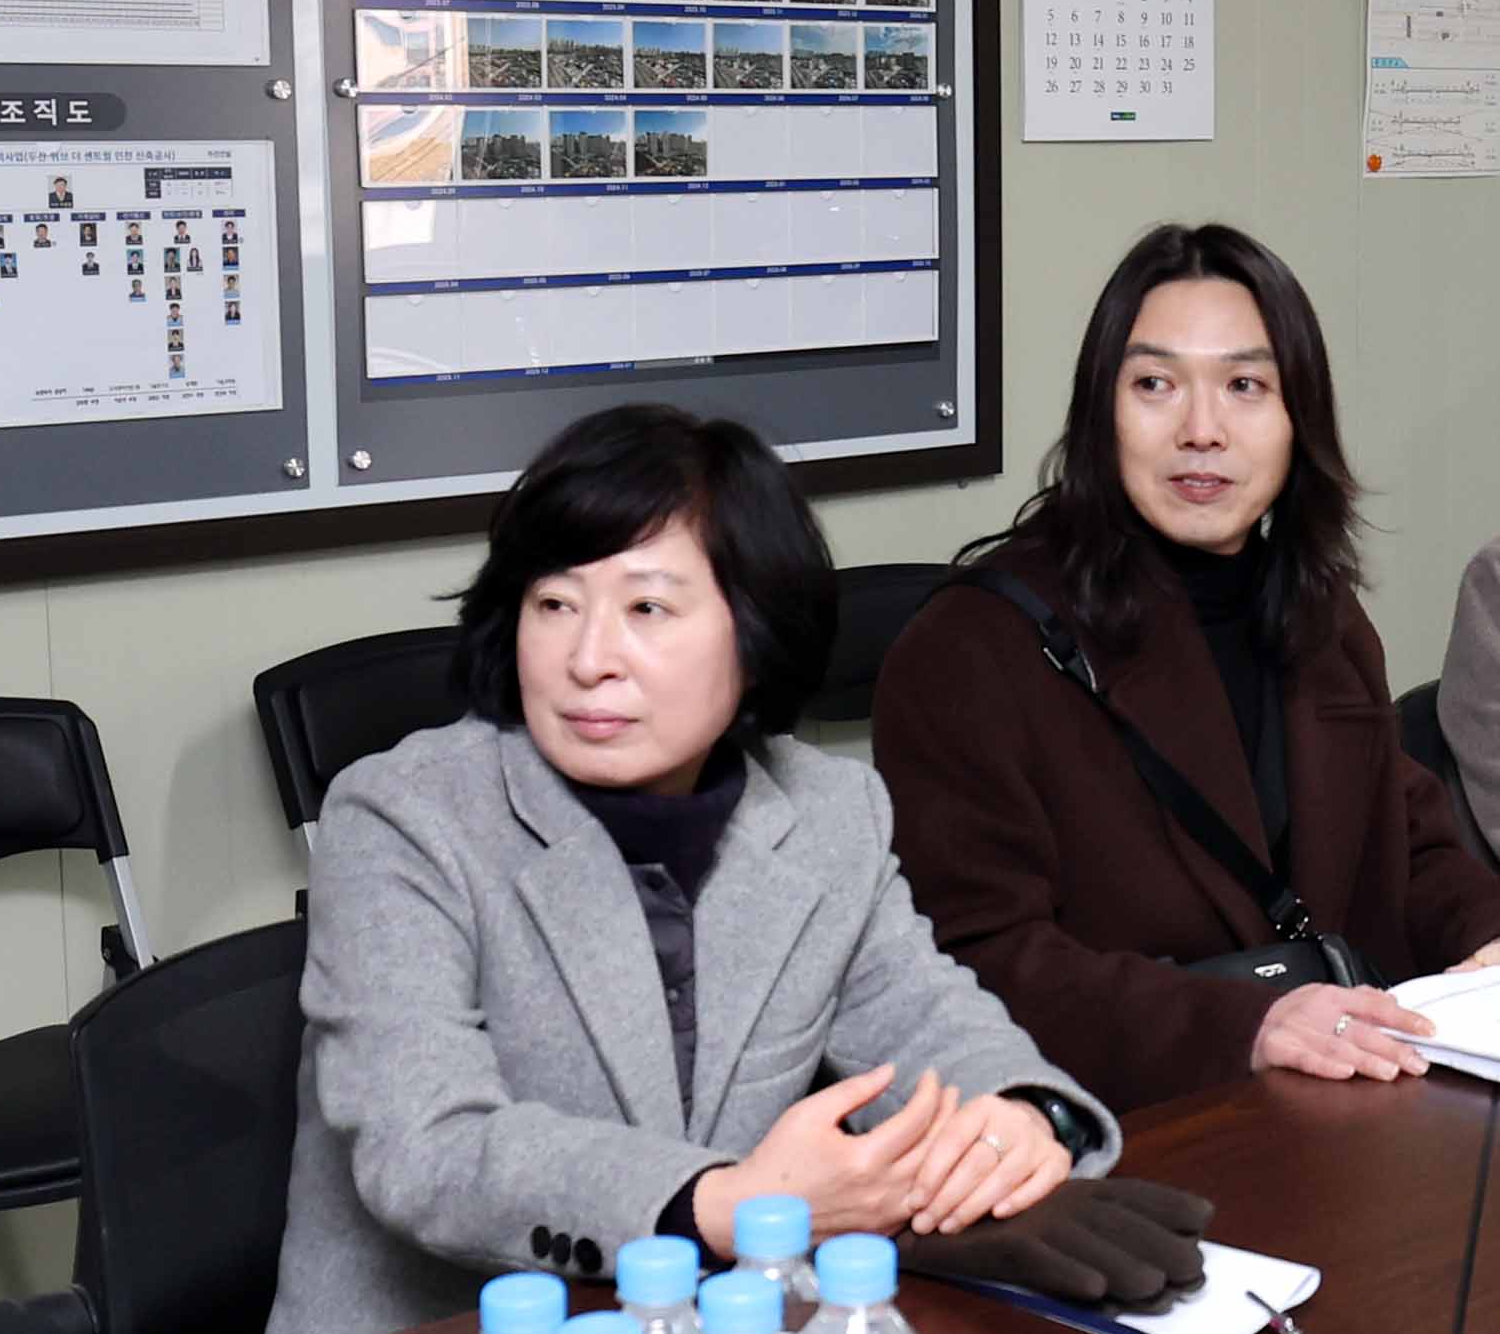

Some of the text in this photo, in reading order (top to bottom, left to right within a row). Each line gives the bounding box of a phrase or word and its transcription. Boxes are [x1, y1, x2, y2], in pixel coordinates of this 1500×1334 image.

[1048, 9, 1195, 26] 5 6 7 8 9 10 11
[1045, 33, 1195, 48] 12 13 14 15 16 17 18
[1046, 57, 1195, 71] 19 20 21 22 23 24 25
[1045, 80, 1173, 94] 26 27 28 29 30 31
